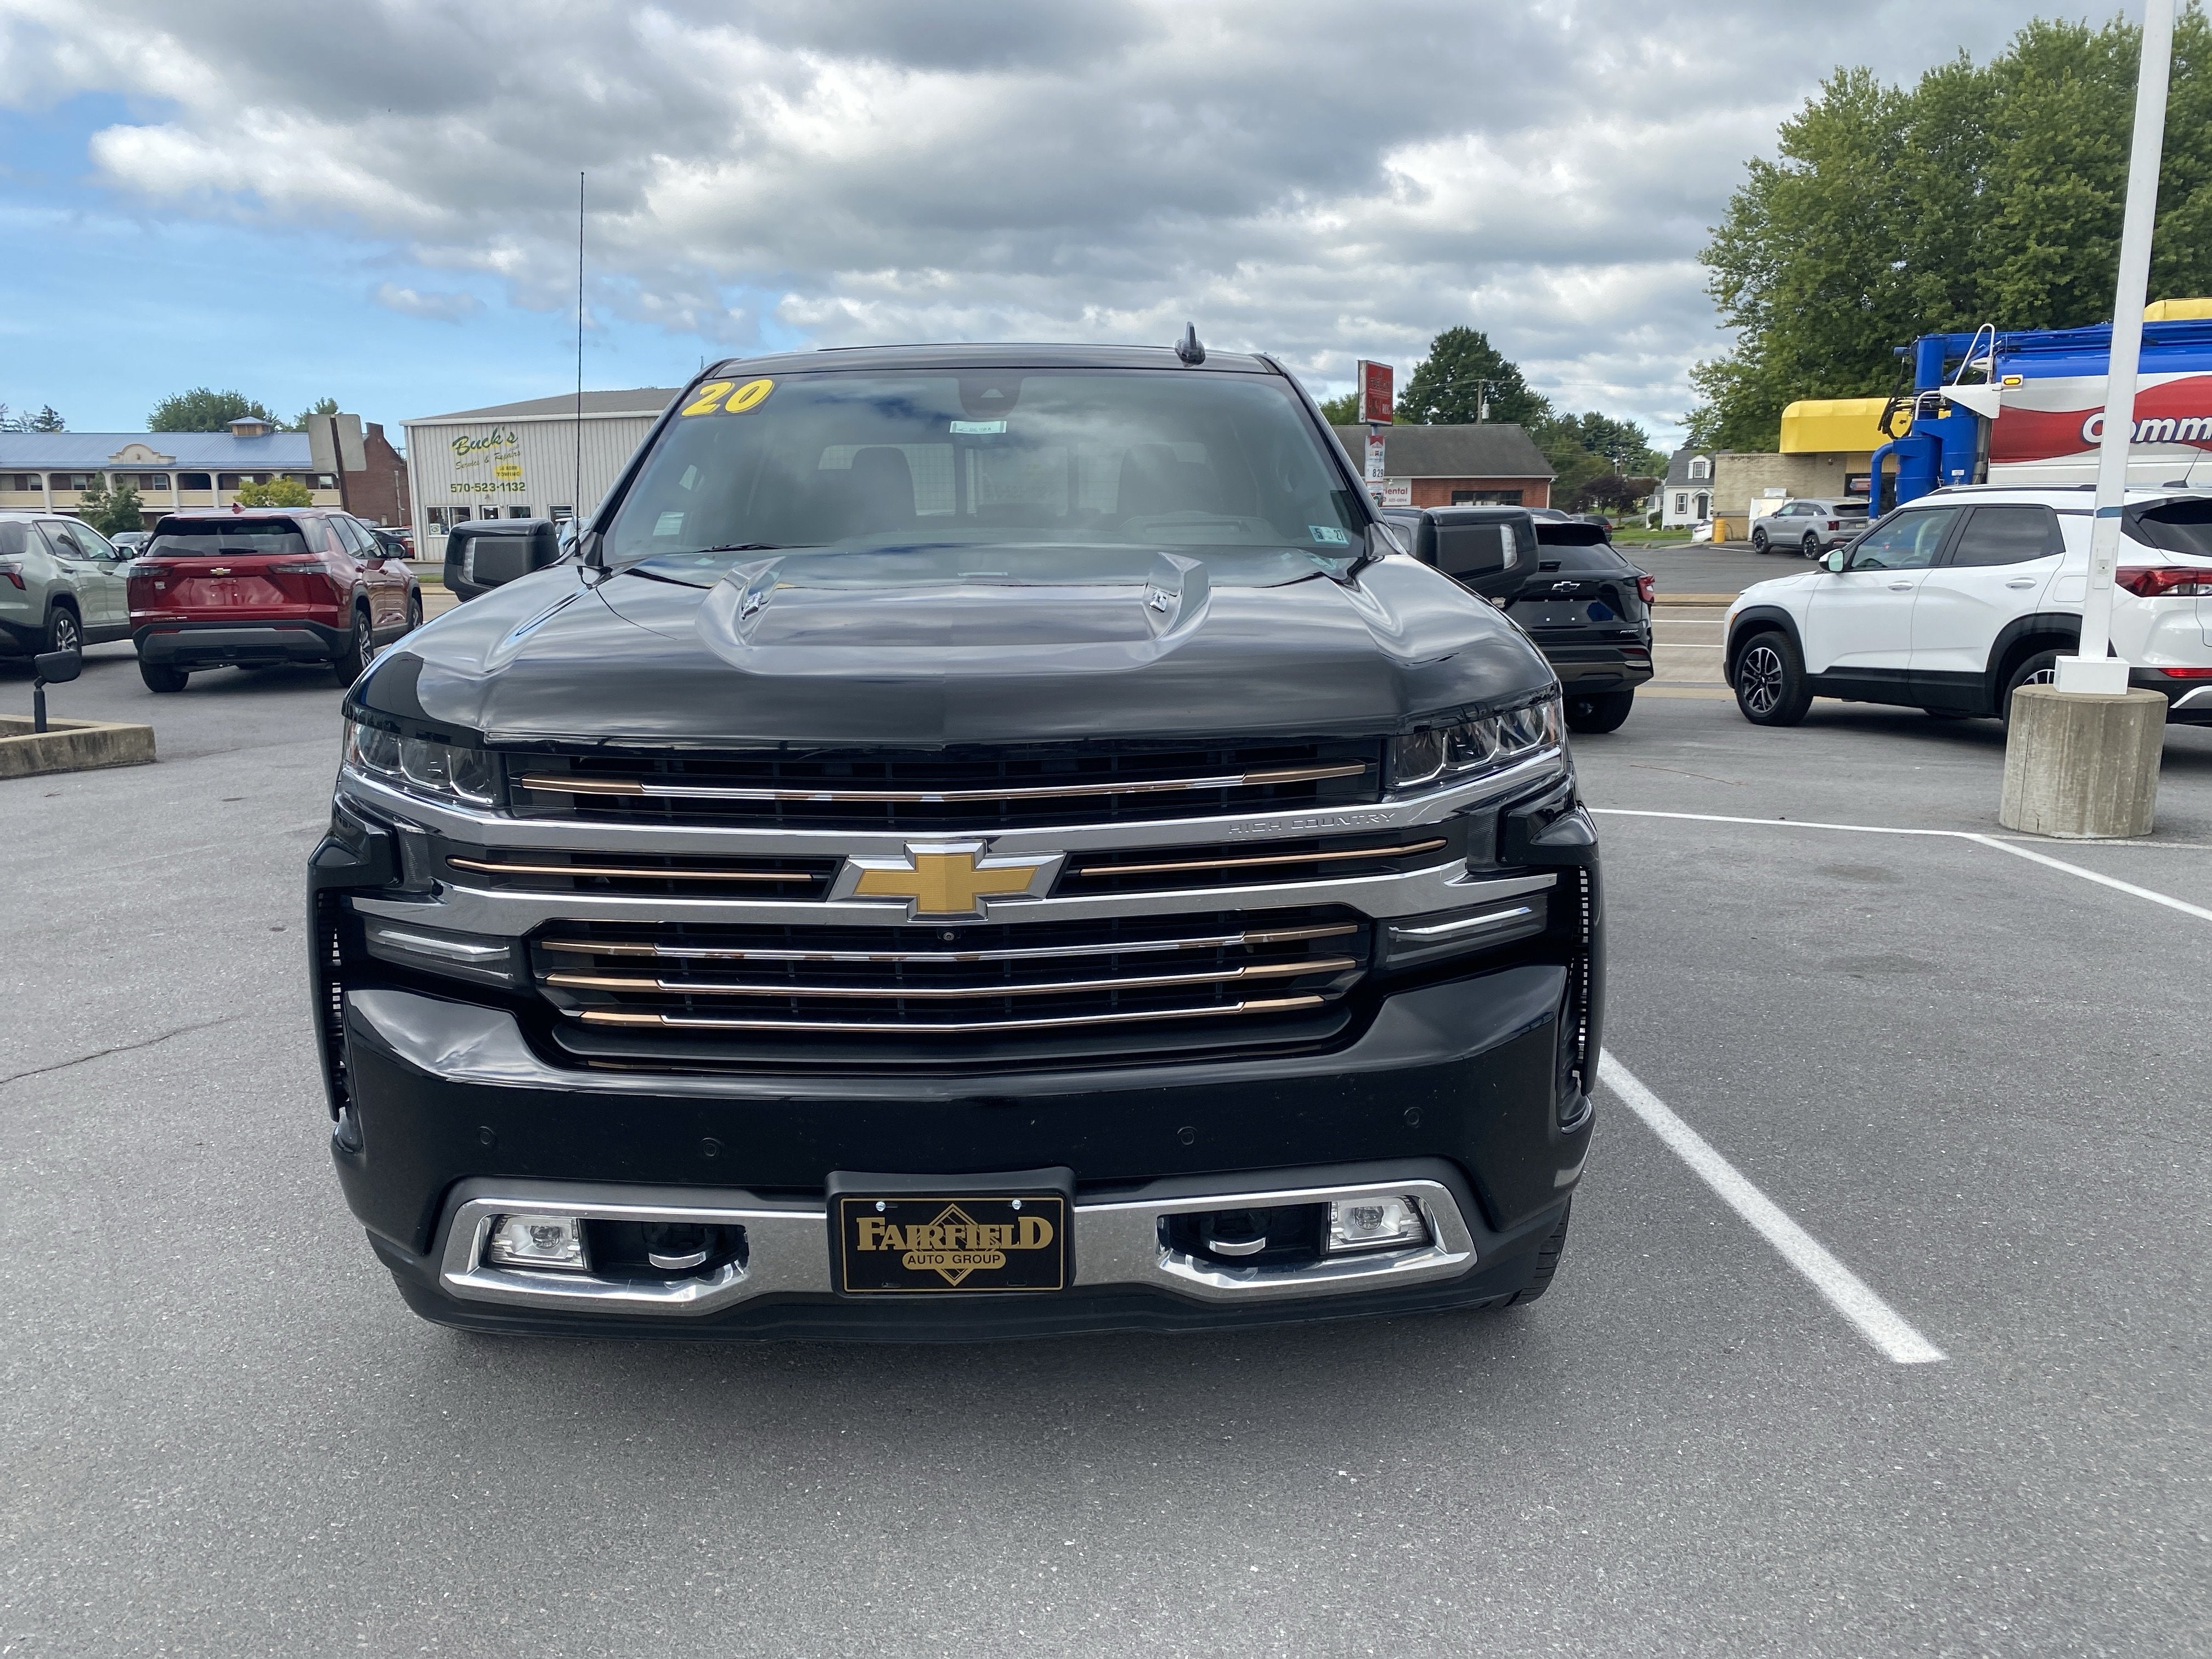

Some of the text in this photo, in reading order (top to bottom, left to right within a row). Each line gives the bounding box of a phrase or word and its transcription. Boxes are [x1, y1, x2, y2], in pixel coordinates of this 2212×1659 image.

[681, 379, 775, 416] 20
[452, 426, 518, 456] Buck's
[2083, 413, 2212, 443] Cmm
[1314, 528, 1344, 542] 5 27
[1228, 812, 1395, 834] HIGH COUNTRY
[907, 1254, 1001, 1265] AUTO GROUP
